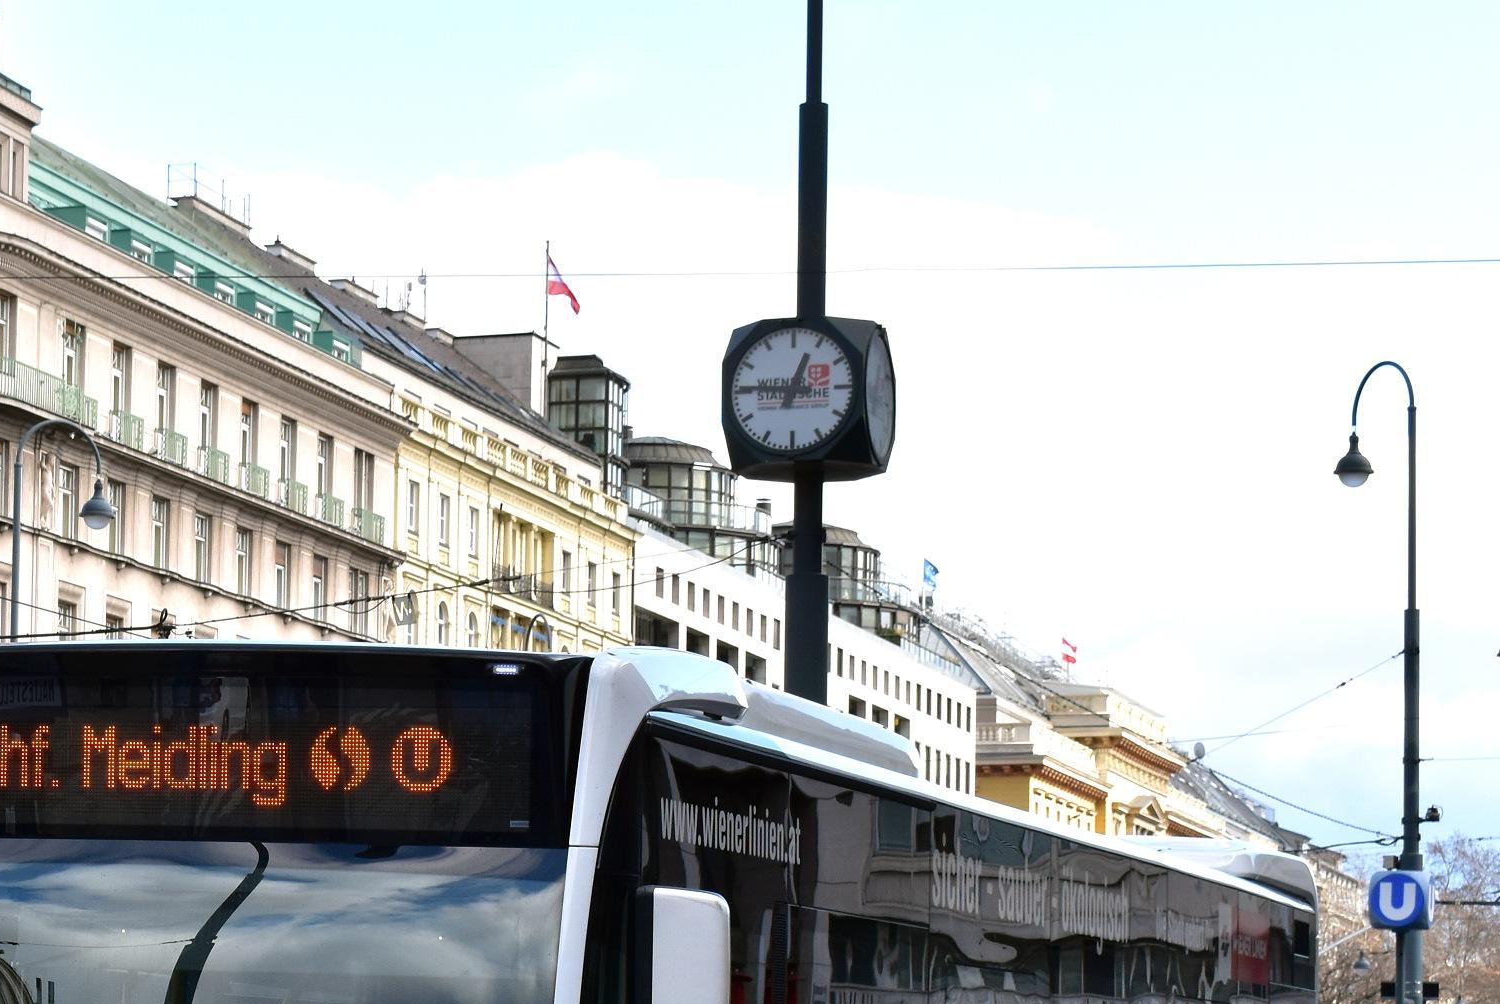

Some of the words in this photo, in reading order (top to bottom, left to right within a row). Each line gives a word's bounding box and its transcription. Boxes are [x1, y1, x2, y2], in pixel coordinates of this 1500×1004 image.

[757, 377, 806, 388] WIENR
[82, 724, 288, 807] Meidling
[660, 796, 800, 865] www.wienerlinien.at
[932, 832, 982, 915] sicher
[998, 853, 1048, 928] sauber
[1378, 882, 1416, 921] U
